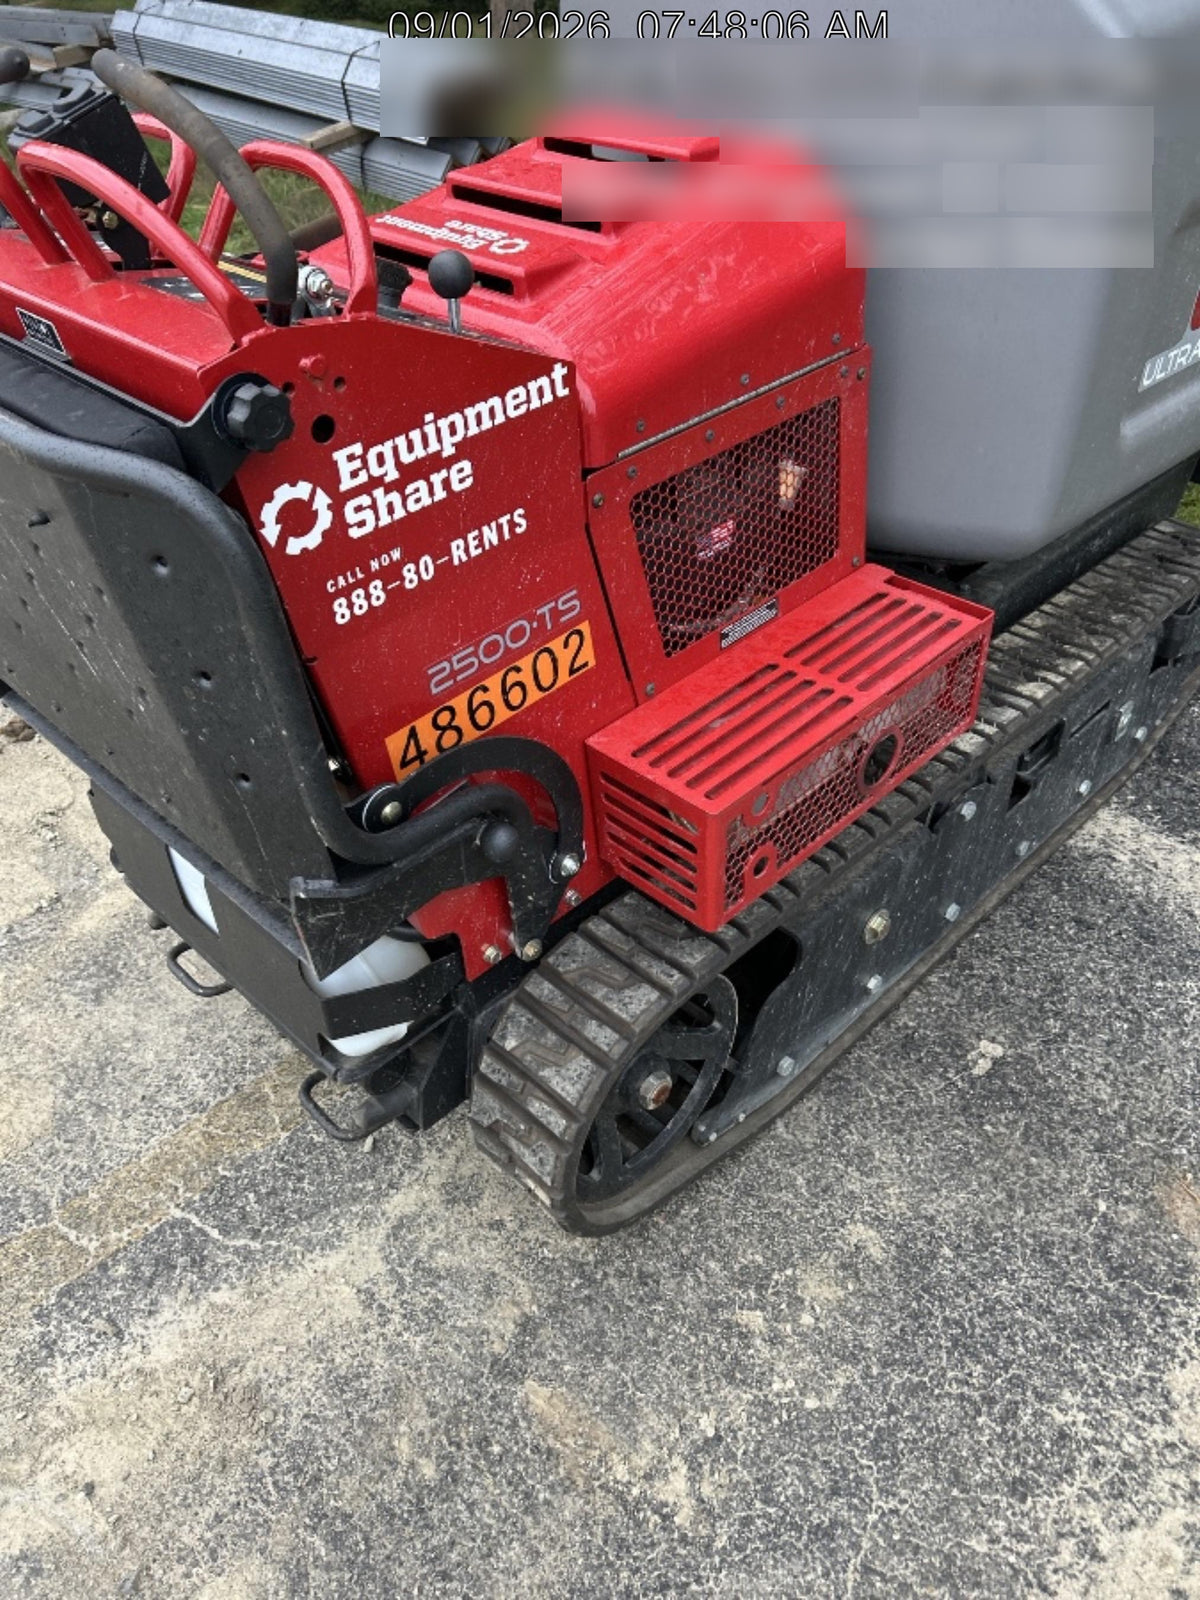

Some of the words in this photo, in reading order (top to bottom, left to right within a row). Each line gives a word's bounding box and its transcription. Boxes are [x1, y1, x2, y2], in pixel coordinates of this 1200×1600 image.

[375, 214, 489, 250] Equipment
[332, 362, 570, 492] Equipment
[343, 458, 475, 540] Share
[326, 565, 365, 593] CALL
[370, 546, 403, 572] NOW
[332, 507, 528, 625] 888-80-RENTS
[399, 628, 590, 770] 486602
